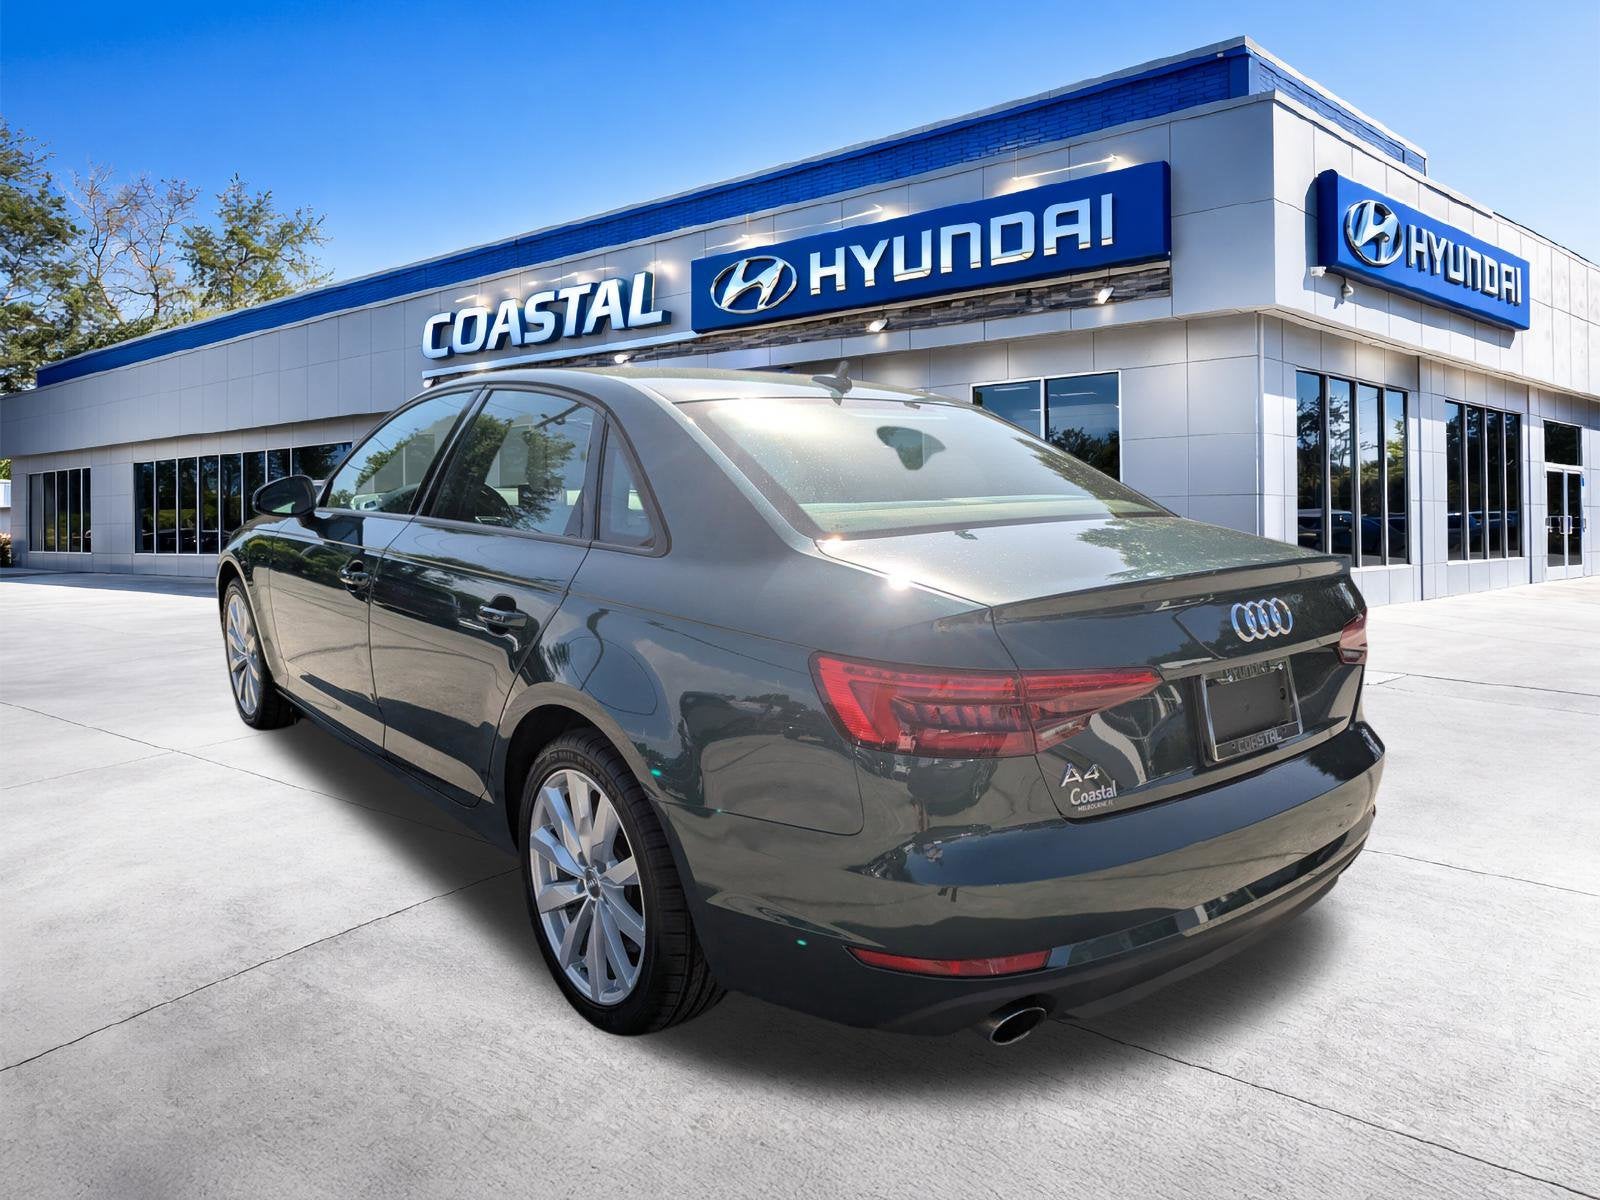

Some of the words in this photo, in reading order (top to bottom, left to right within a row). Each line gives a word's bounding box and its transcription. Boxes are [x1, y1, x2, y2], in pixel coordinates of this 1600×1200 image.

[809, 192, 1113, 296] HYUNDAI
[1406, 223, 1522, 306] HYUNDAI
[422, 271, 668, 359] COASTAL
[1238, 730, 1282, 752] COASTAL
[1061, 762, 1100, 787] A4
[1070, 779, 1118, 806] Coastal
